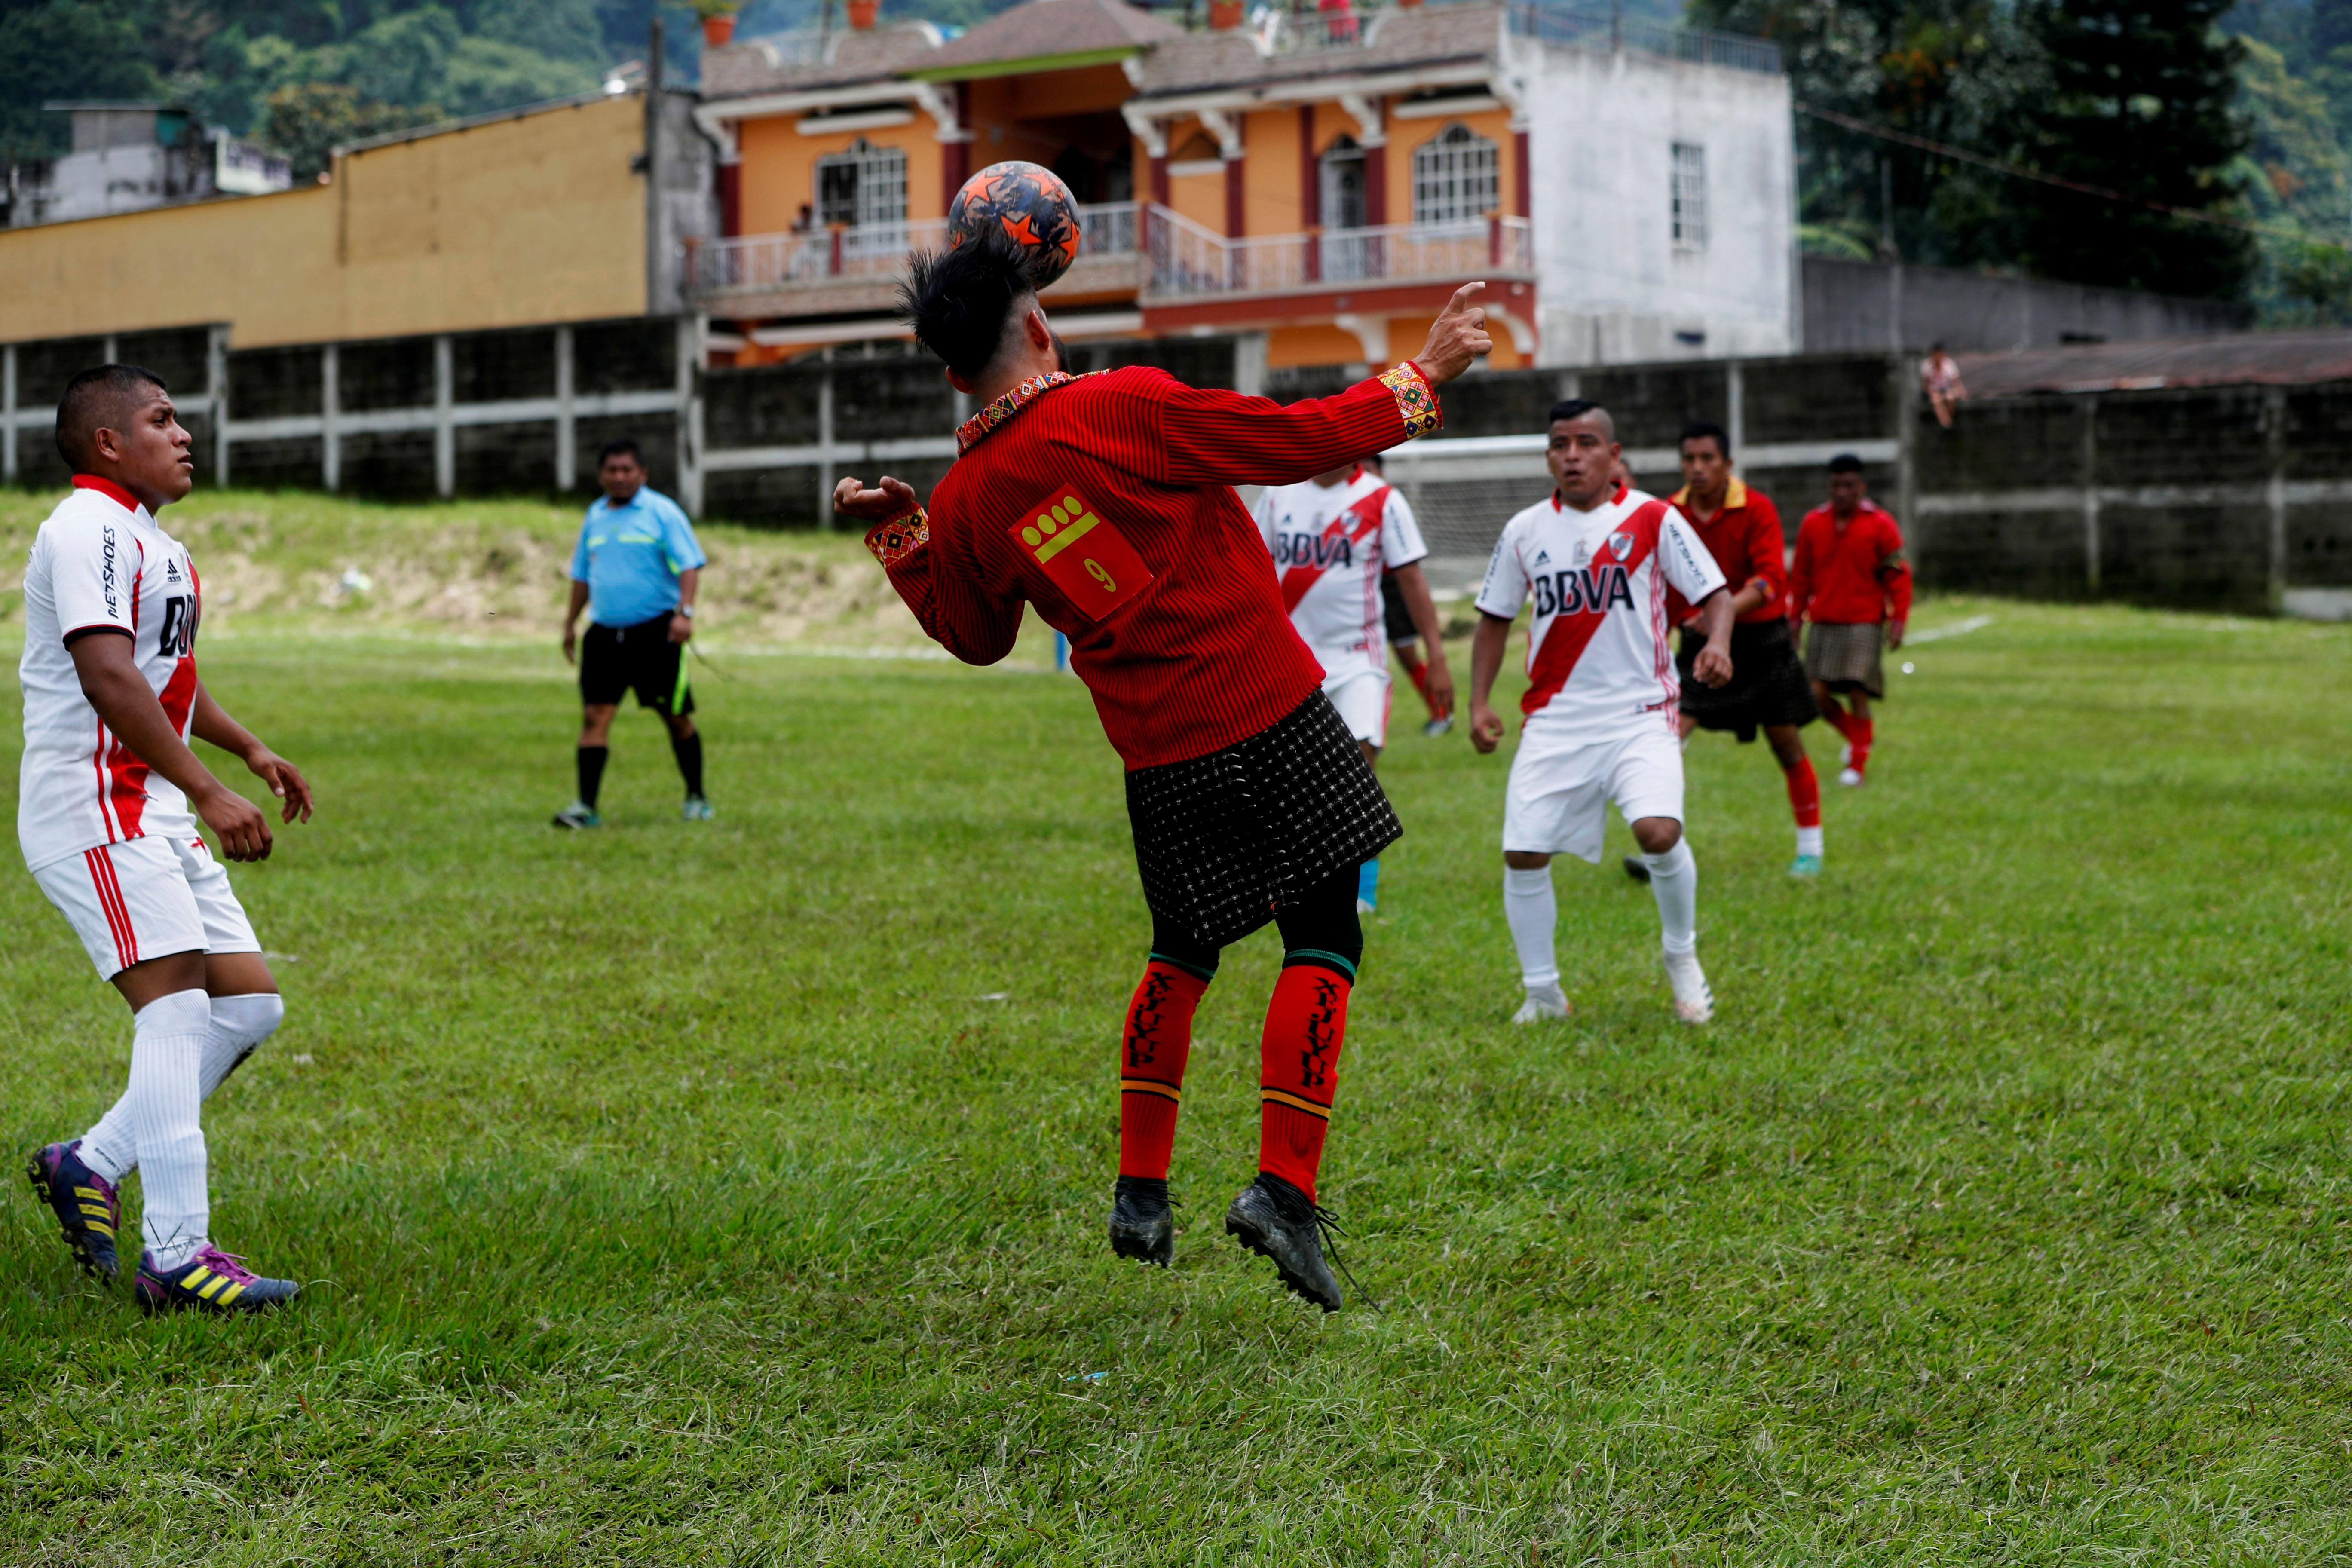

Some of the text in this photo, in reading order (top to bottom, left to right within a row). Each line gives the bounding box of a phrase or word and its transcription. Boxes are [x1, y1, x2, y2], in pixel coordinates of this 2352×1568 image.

[103, 524, 119, 619] NETSHOES
[1084, 558, 1116, 592] 9
[1276, 532, 1352, 568] BBVA
[1670, 524, 1708, 587] NETSHOES
[1534, 566, 1635, 618] BBVA
[1126, 971, 1176, 1068] XEJUYUP
[1298, 976, 1341, 1089] XEJUYUP
